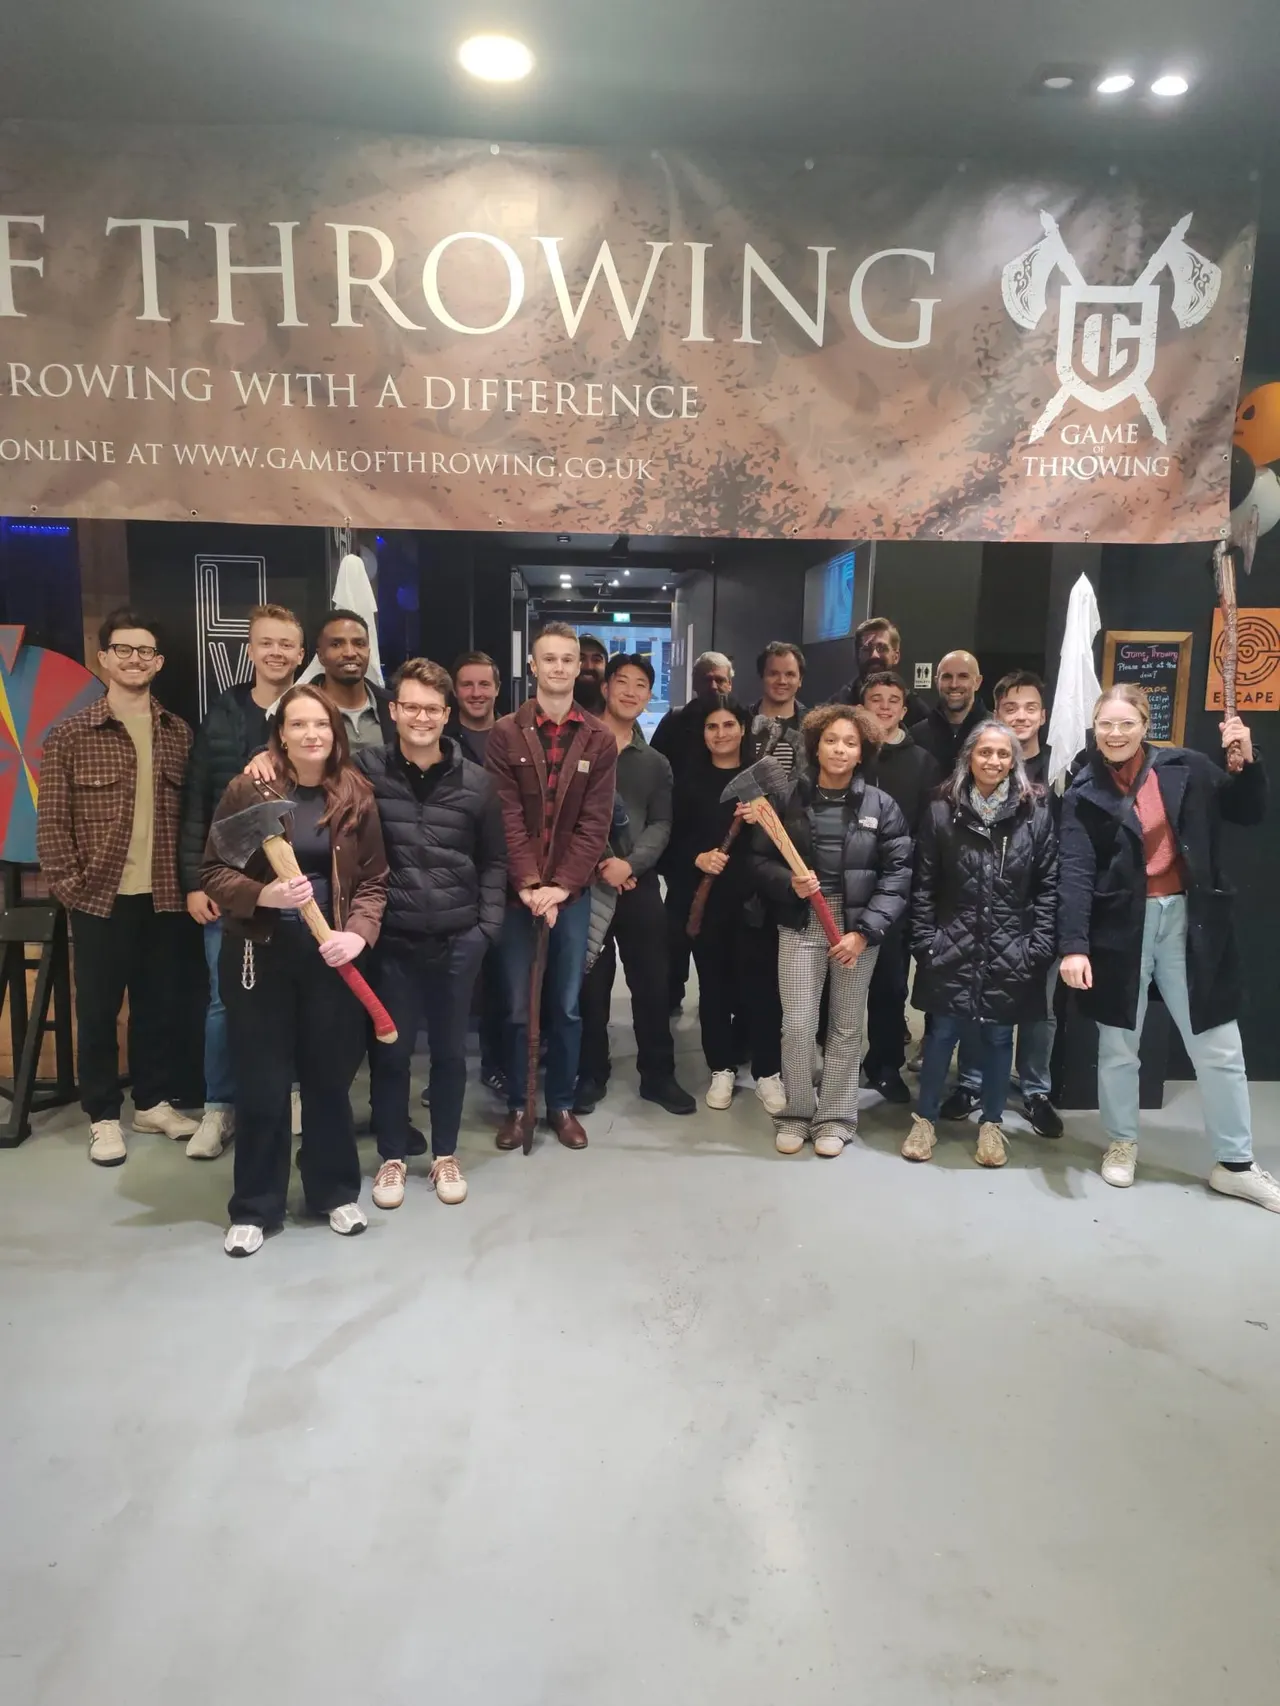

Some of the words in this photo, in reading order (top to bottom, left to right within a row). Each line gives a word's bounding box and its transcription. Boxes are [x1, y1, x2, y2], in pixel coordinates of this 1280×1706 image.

[105, 216, 941, 350] THROWING
[0, 361, 214, 402] ROWING
[230, 369, 356, 408] WITH
[375, 373, 407, 409] A
[423, 375, 699, 419] DIFFERENCE
[1060, 423, 1139, 445] GAME
[0, 438, 116, 464] ONLINE
[126, 443, 164, 465] AT
[172, 443, 655, 481] WWW.GAMEOFTHROWING.CO.UK
[1092, 445, 1106, 454] OF
[1022, 455, 1170, 480] THROWING
[1117, 663, 1138, 671] Please
[1166, 661, 1177, 669] the
[1213, 691, 1274, 703] ECAPE
